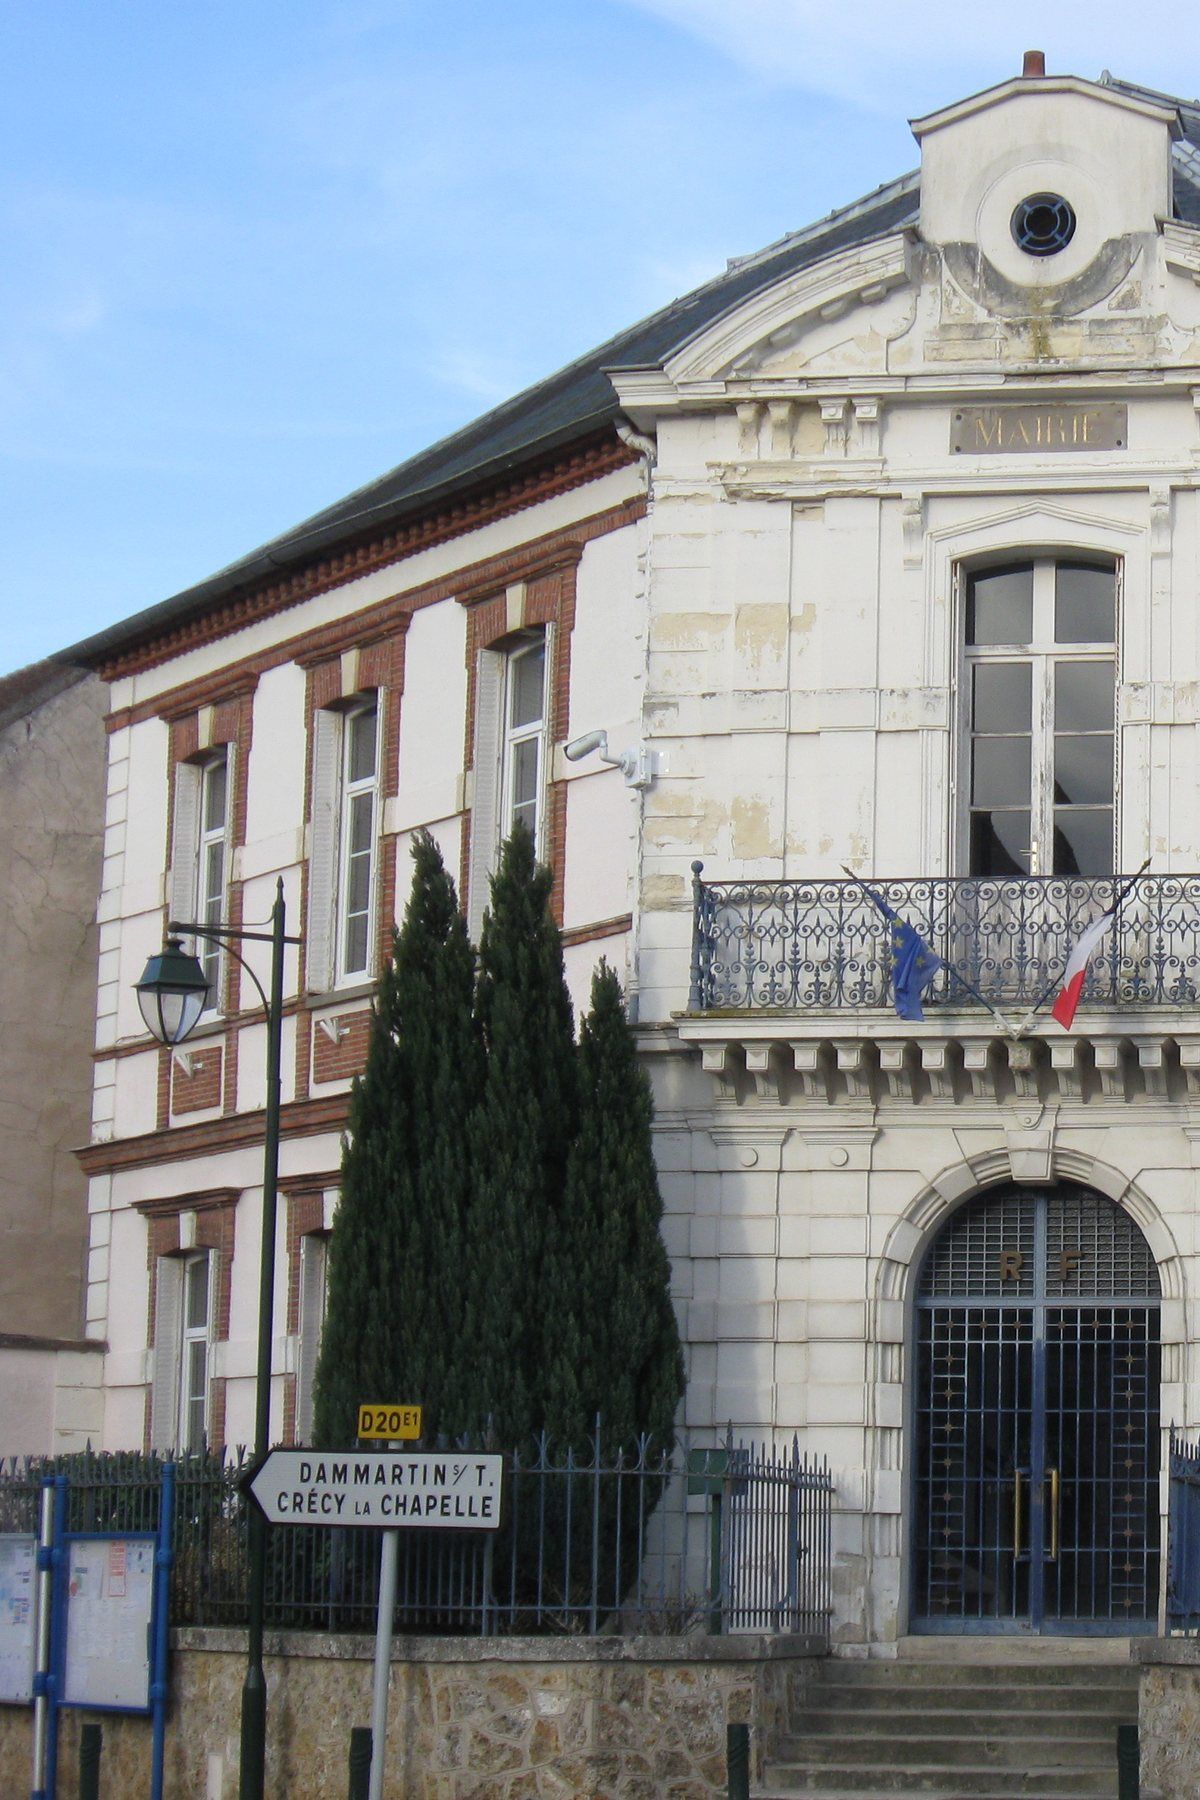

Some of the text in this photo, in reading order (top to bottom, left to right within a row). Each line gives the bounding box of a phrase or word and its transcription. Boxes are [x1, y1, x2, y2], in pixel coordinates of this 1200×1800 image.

[975, 412, 1102, 447] MAIRIE
[999, 1250, 1083, 1281] R F
[300, 1462, 446, 1486] DAMMARTIN
[277, 1487, 493, 1518] CRÉCY LA CHAPELLE
